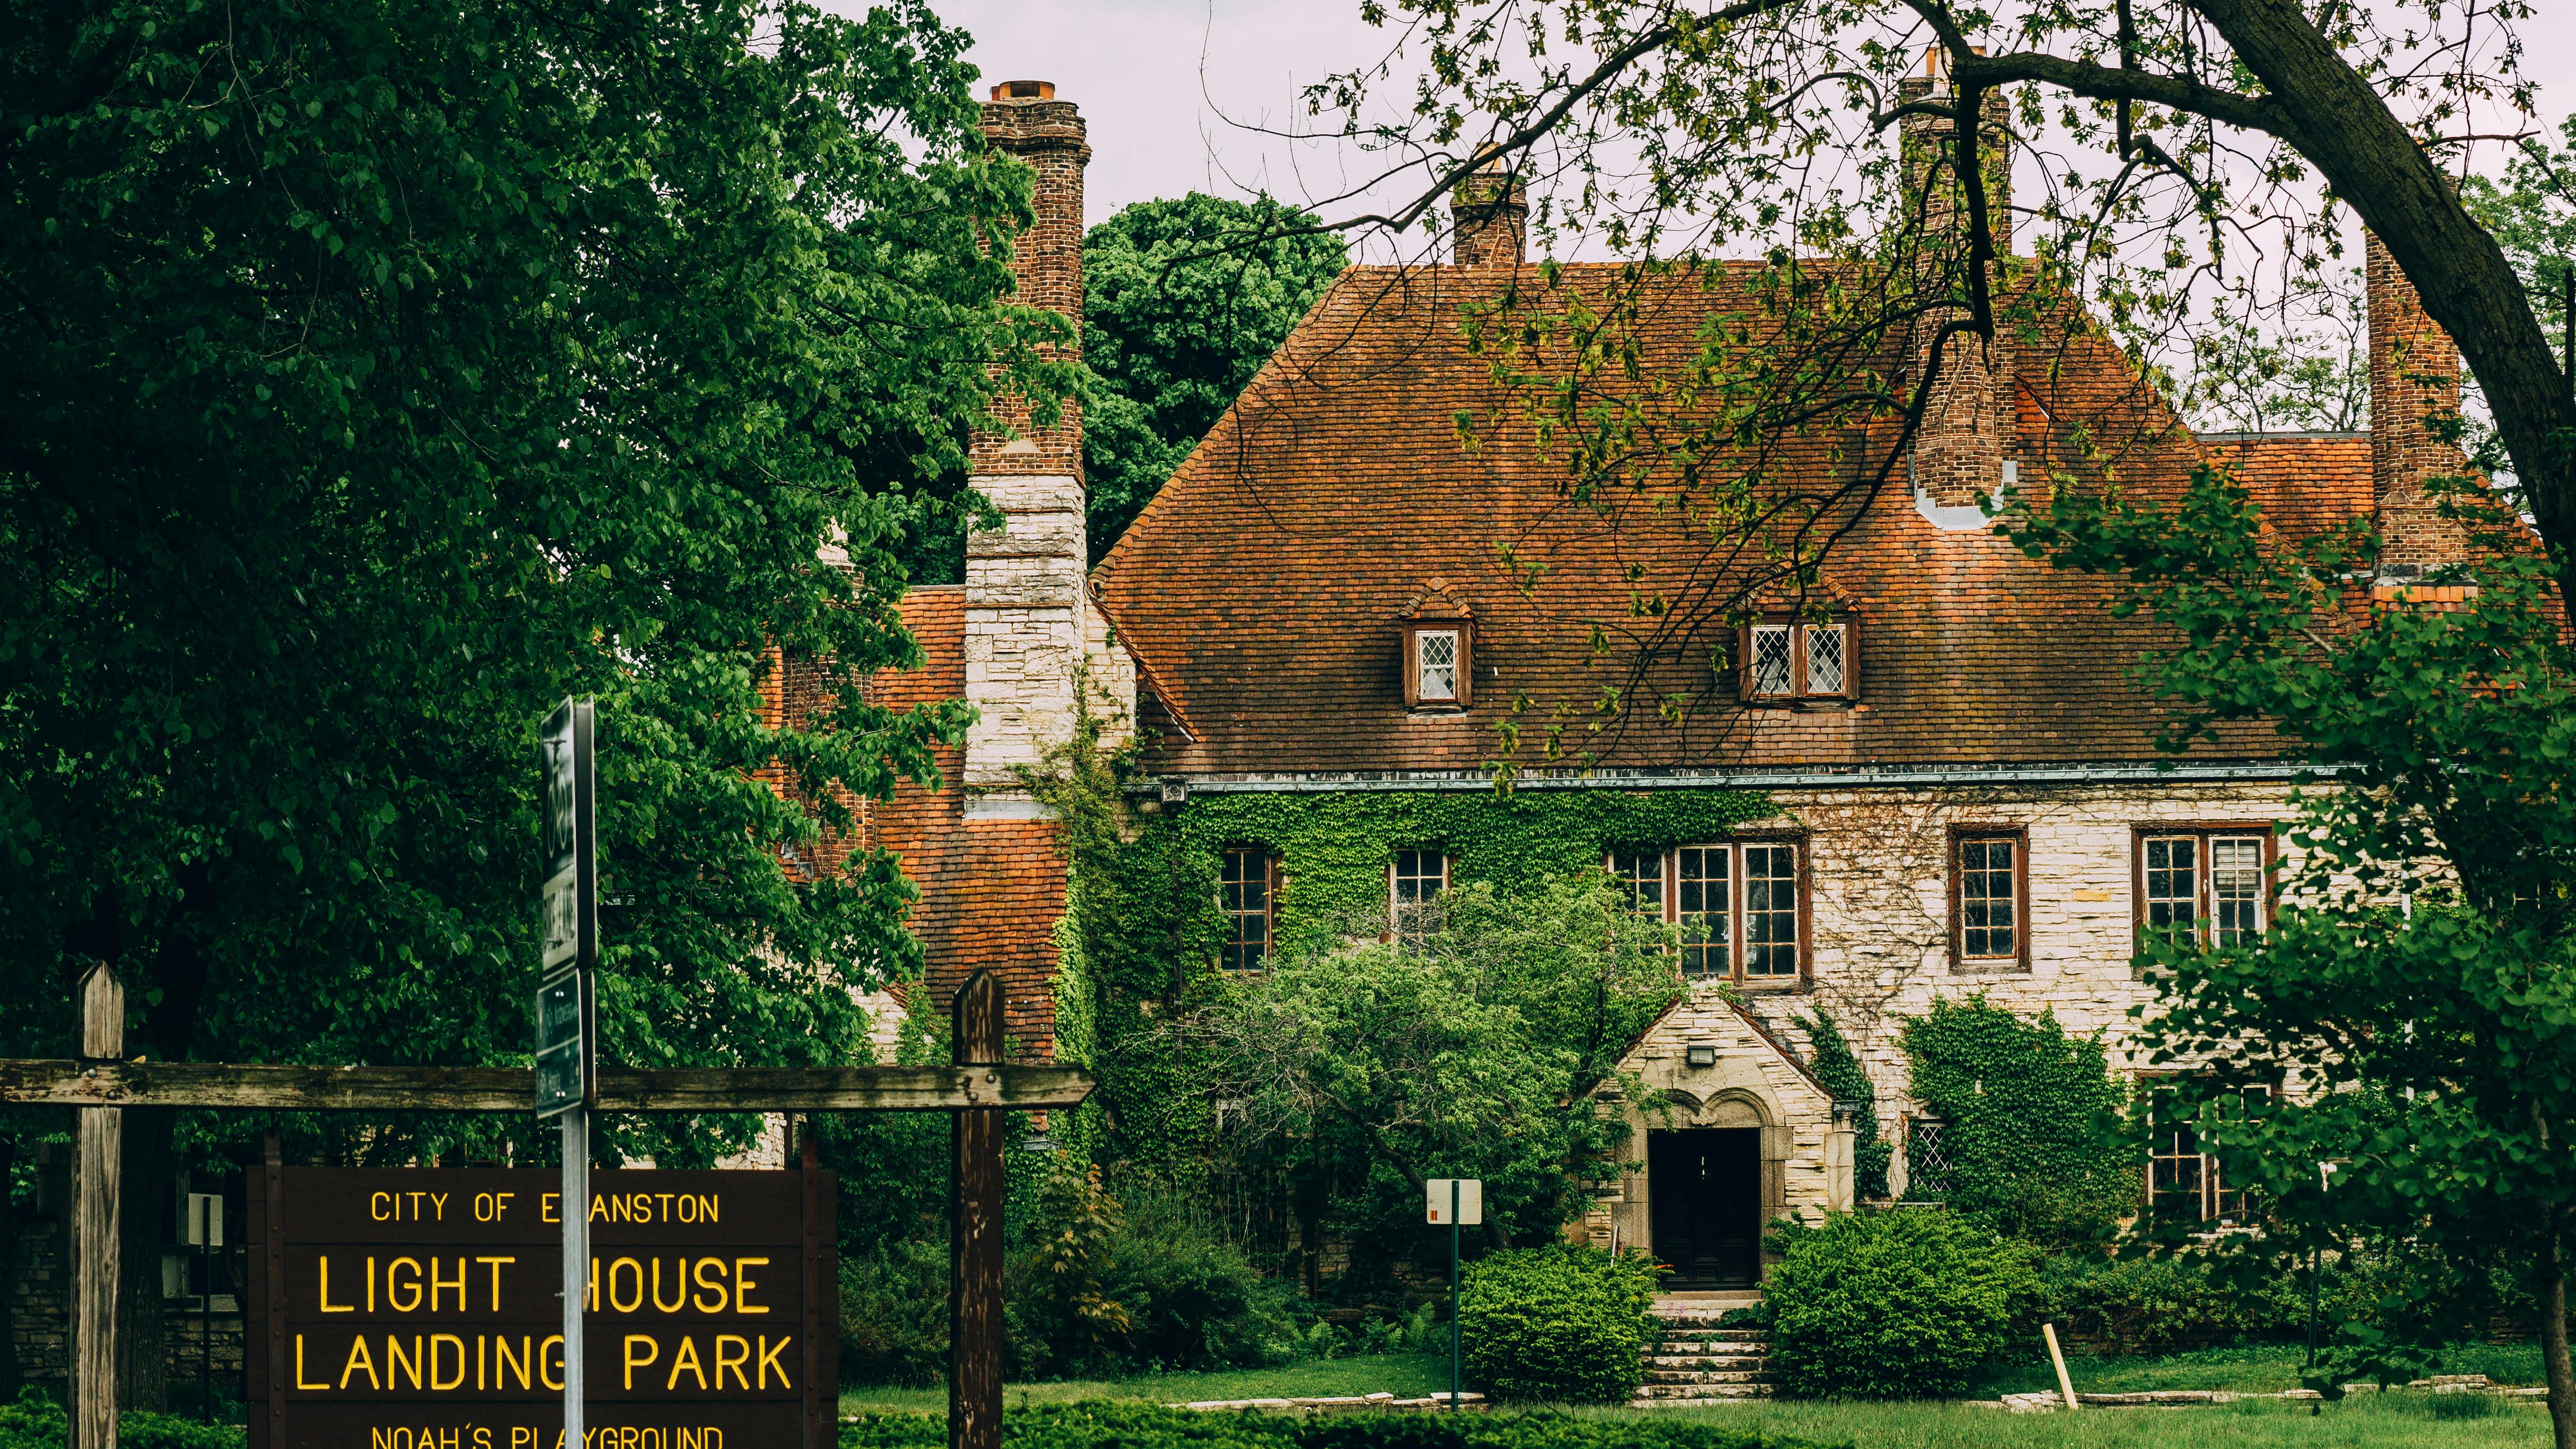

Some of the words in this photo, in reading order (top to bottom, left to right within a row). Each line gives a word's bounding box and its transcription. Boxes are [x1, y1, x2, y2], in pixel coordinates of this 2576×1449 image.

[372, 1191, 449, 1222] CITY
[475, 1192, 515, 1222] OF
[542, 1192, 719, 1223] EANSTON
[319, 1256, 515, 1313] LIGHT
[296, 1333, 565, 1391] LANDING
[624, 1333, 792, 1391] PARK
[372, 1422, 492, 1449] NOAH'S
